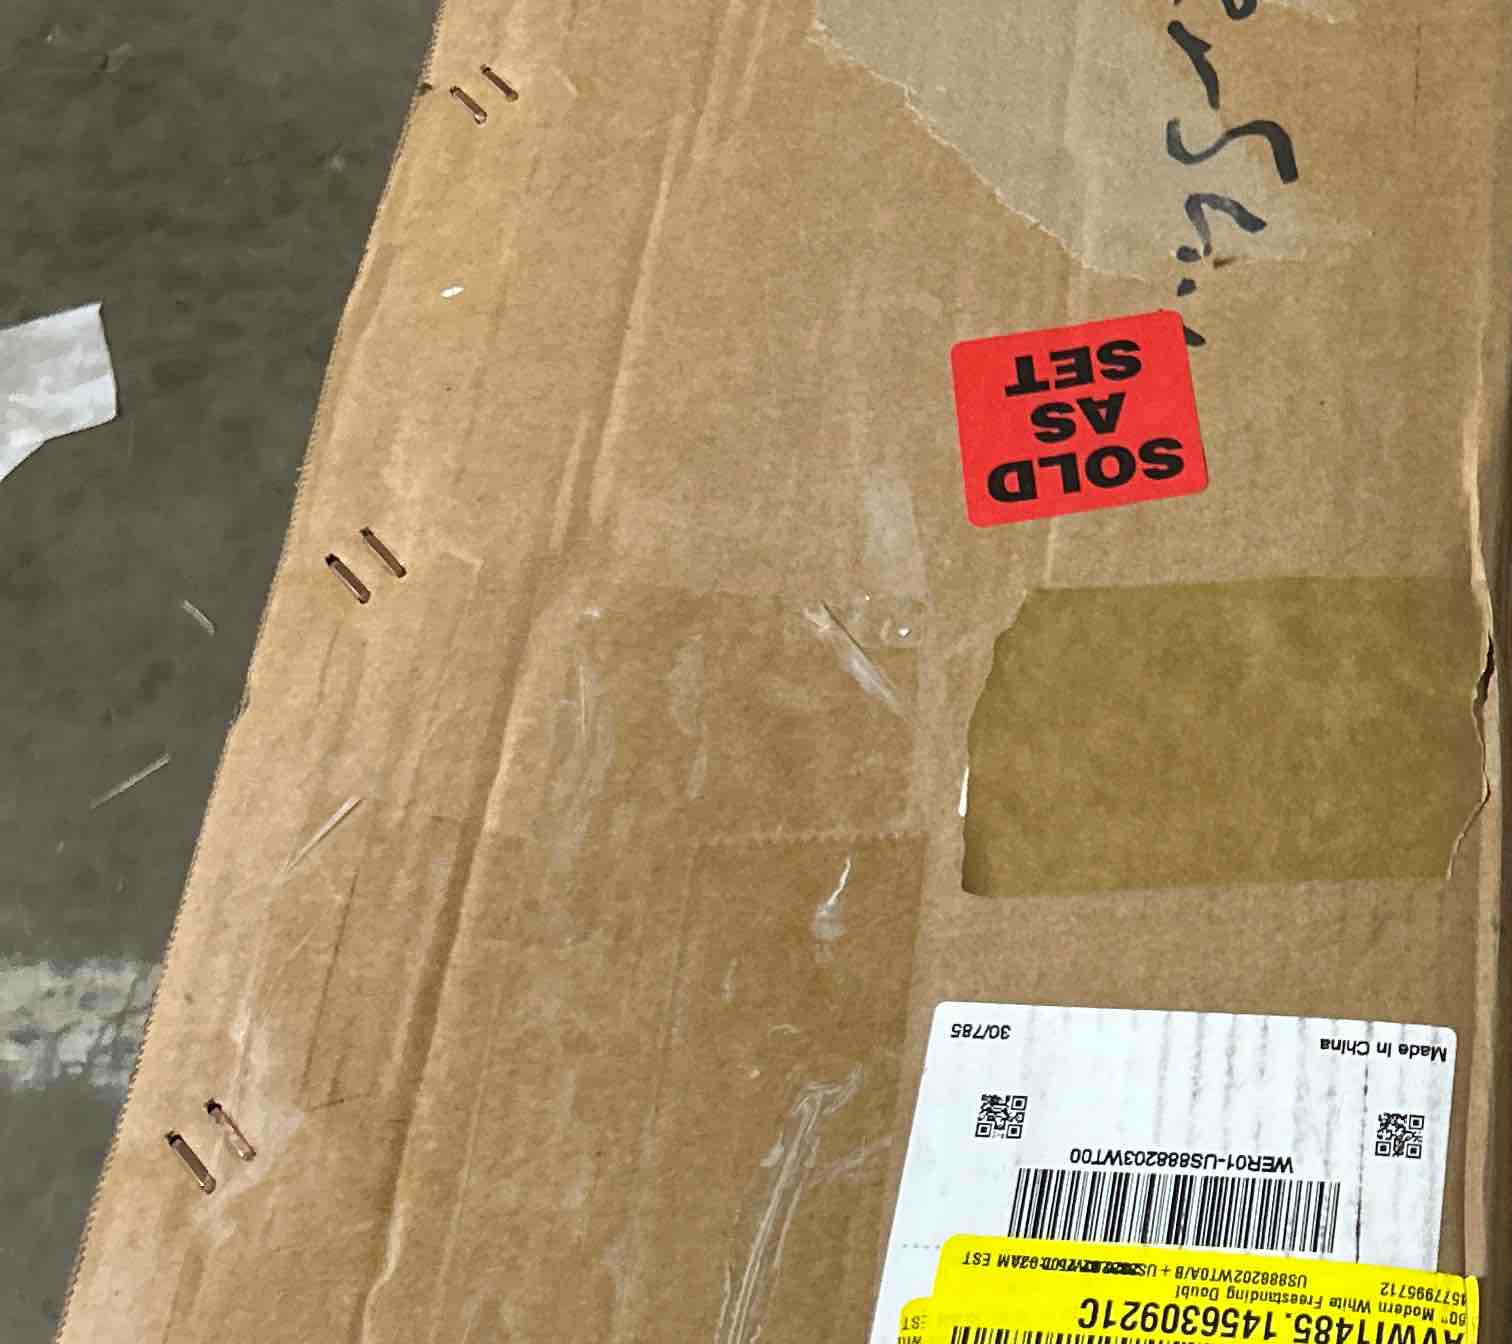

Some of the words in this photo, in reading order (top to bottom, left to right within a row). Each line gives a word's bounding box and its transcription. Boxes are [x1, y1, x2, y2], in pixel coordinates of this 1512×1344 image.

[1004, 338, 1143, 397] SET
[1028, 391, 1127, 444] AS
[987, 437, 1186, 504] SOLD
[950, 1023, 1012, 1040] 30/785
[1319, 1037, 1371, 1057] China
[1398, 1042, 1448, 1063] Made
[1069, 1147, 1295, 1174] WER01-US888203WT00
[962, 1251, 992, 1267] EST
[1175, 1283, 1221, 1302] Doubl
[1226, 1285, 1323, 1310] Freestanding
[1329, 1297, 1372, 1315] White
[1378, 1301, 1436, 1323] Modern
